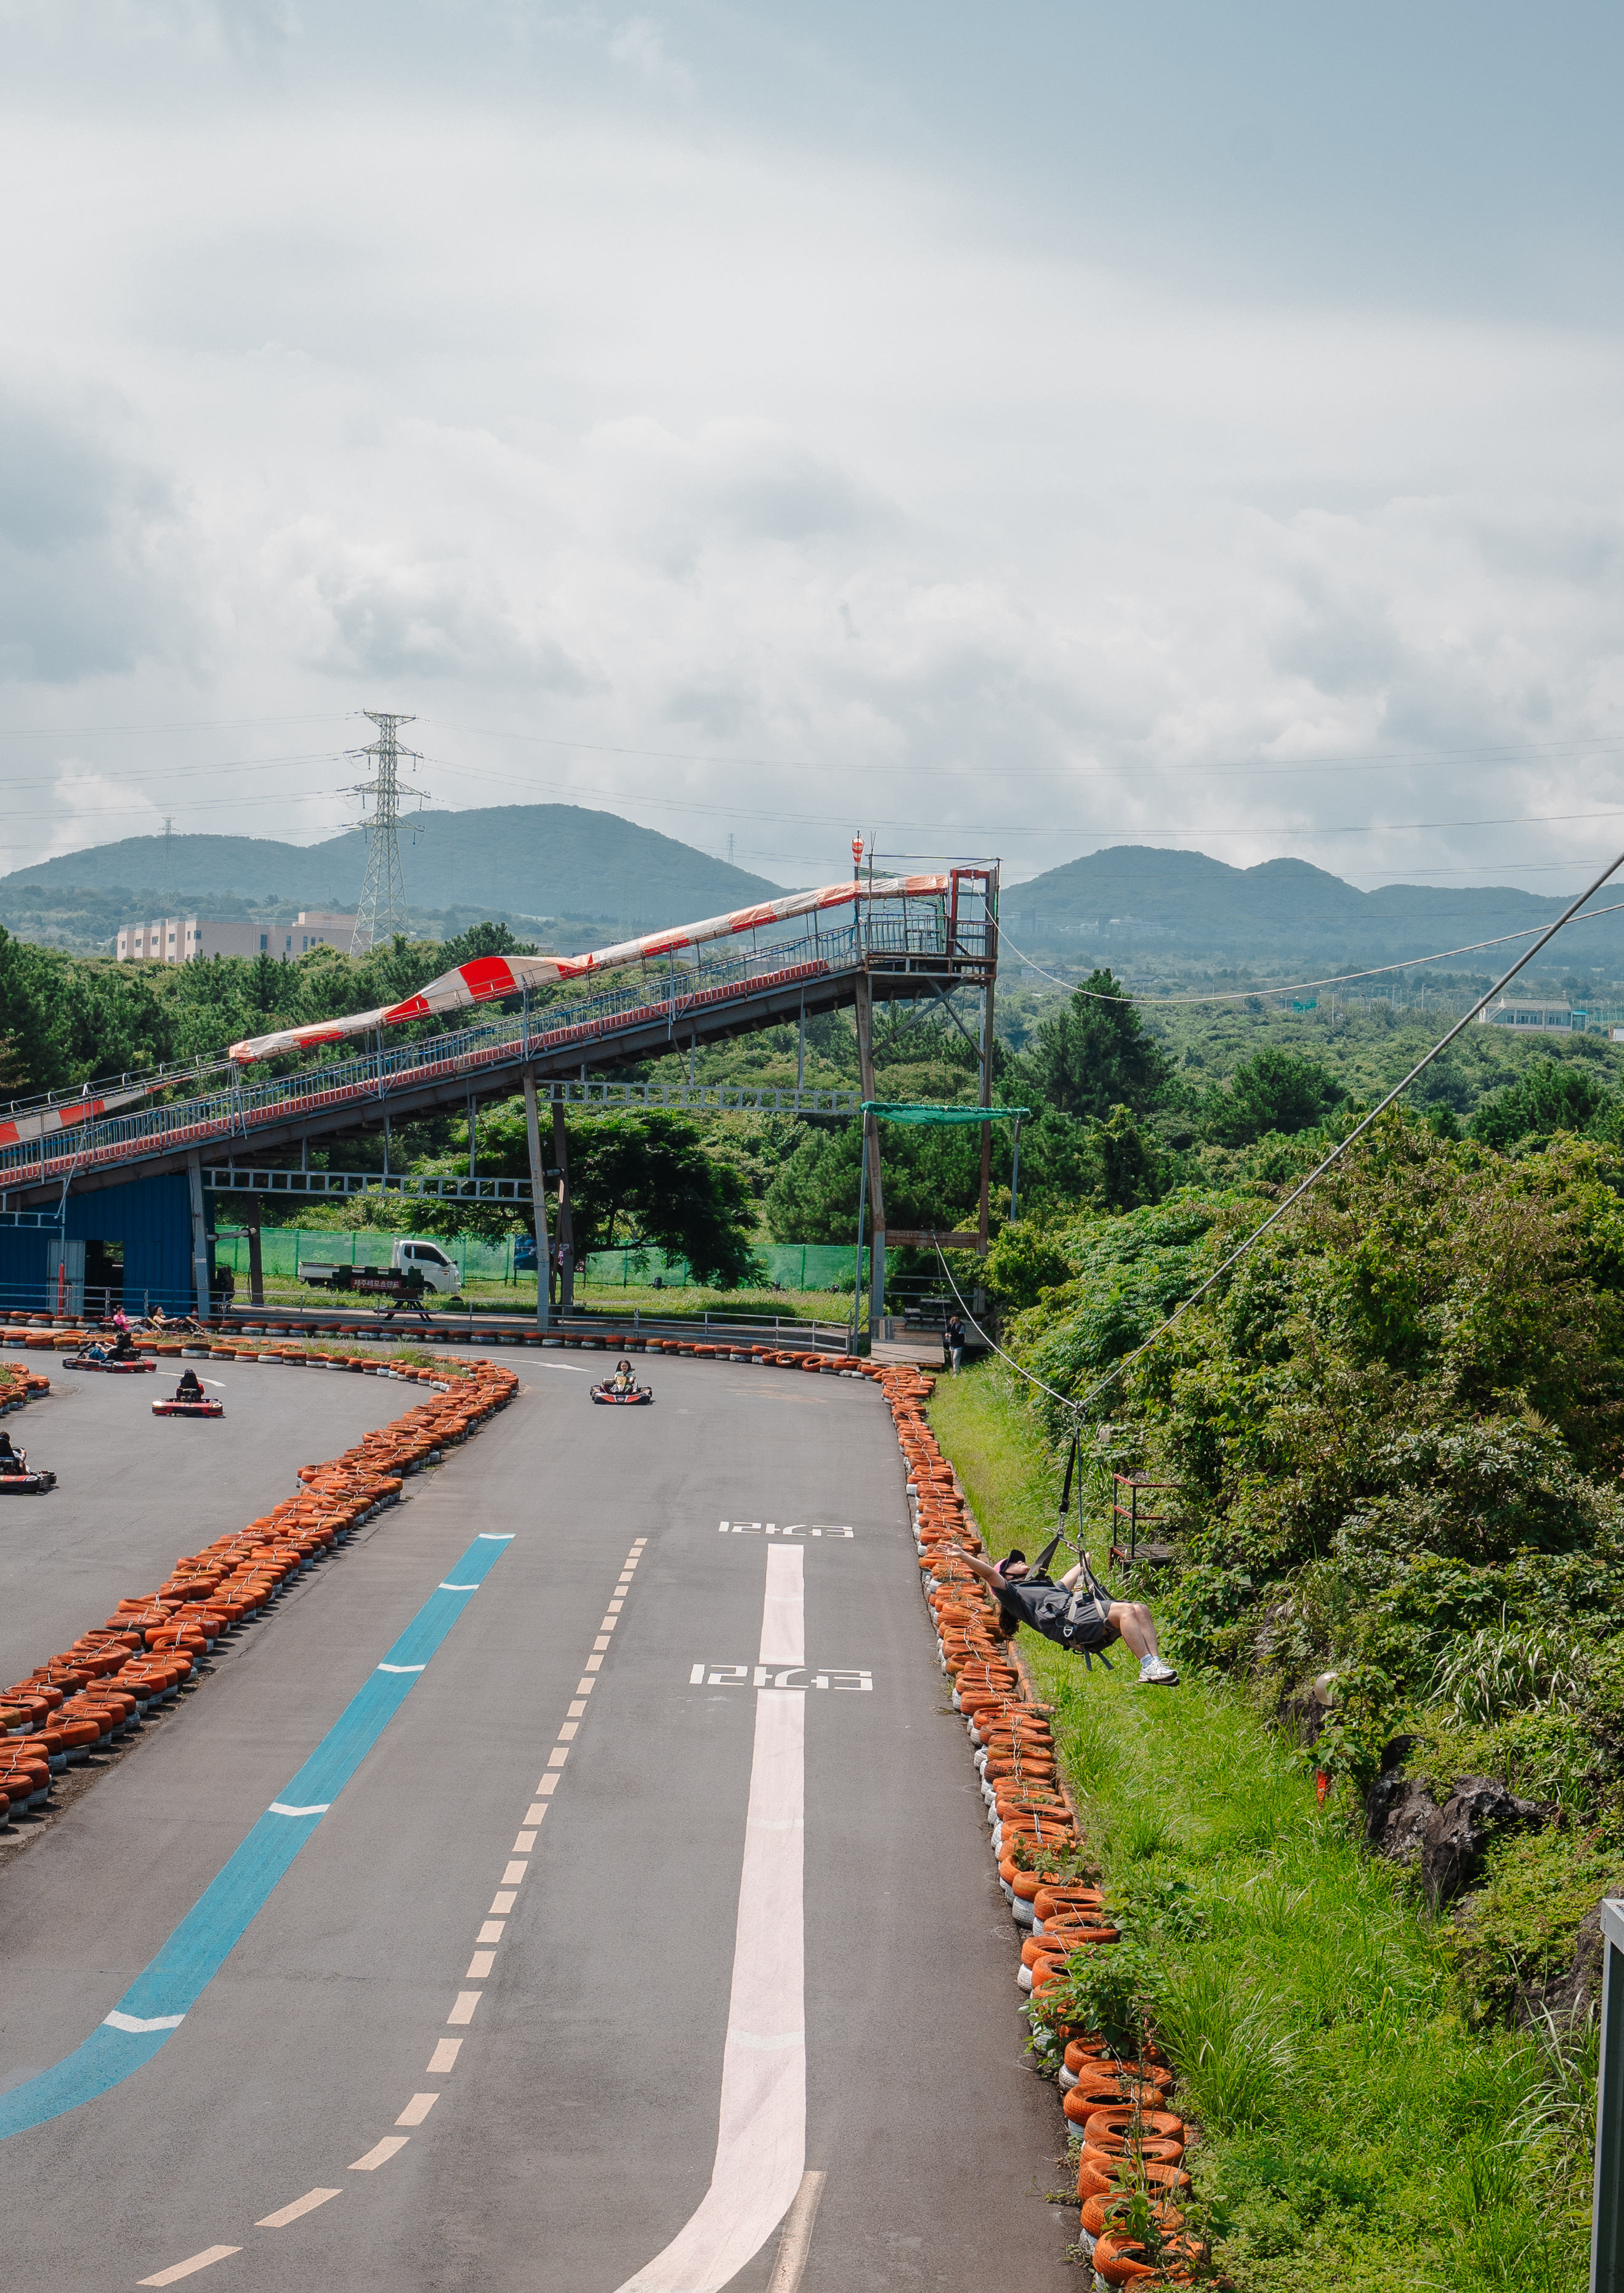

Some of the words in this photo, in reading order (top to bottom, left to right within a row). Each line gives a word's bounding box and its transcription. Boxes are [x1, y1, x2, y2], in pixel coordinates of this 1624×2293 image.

[353, 1279, 400, 1288] 제주레포츠랜드
[718, 1521, 854, 1539] 단거리
[689, 1664, 873, 1691] 단거리
